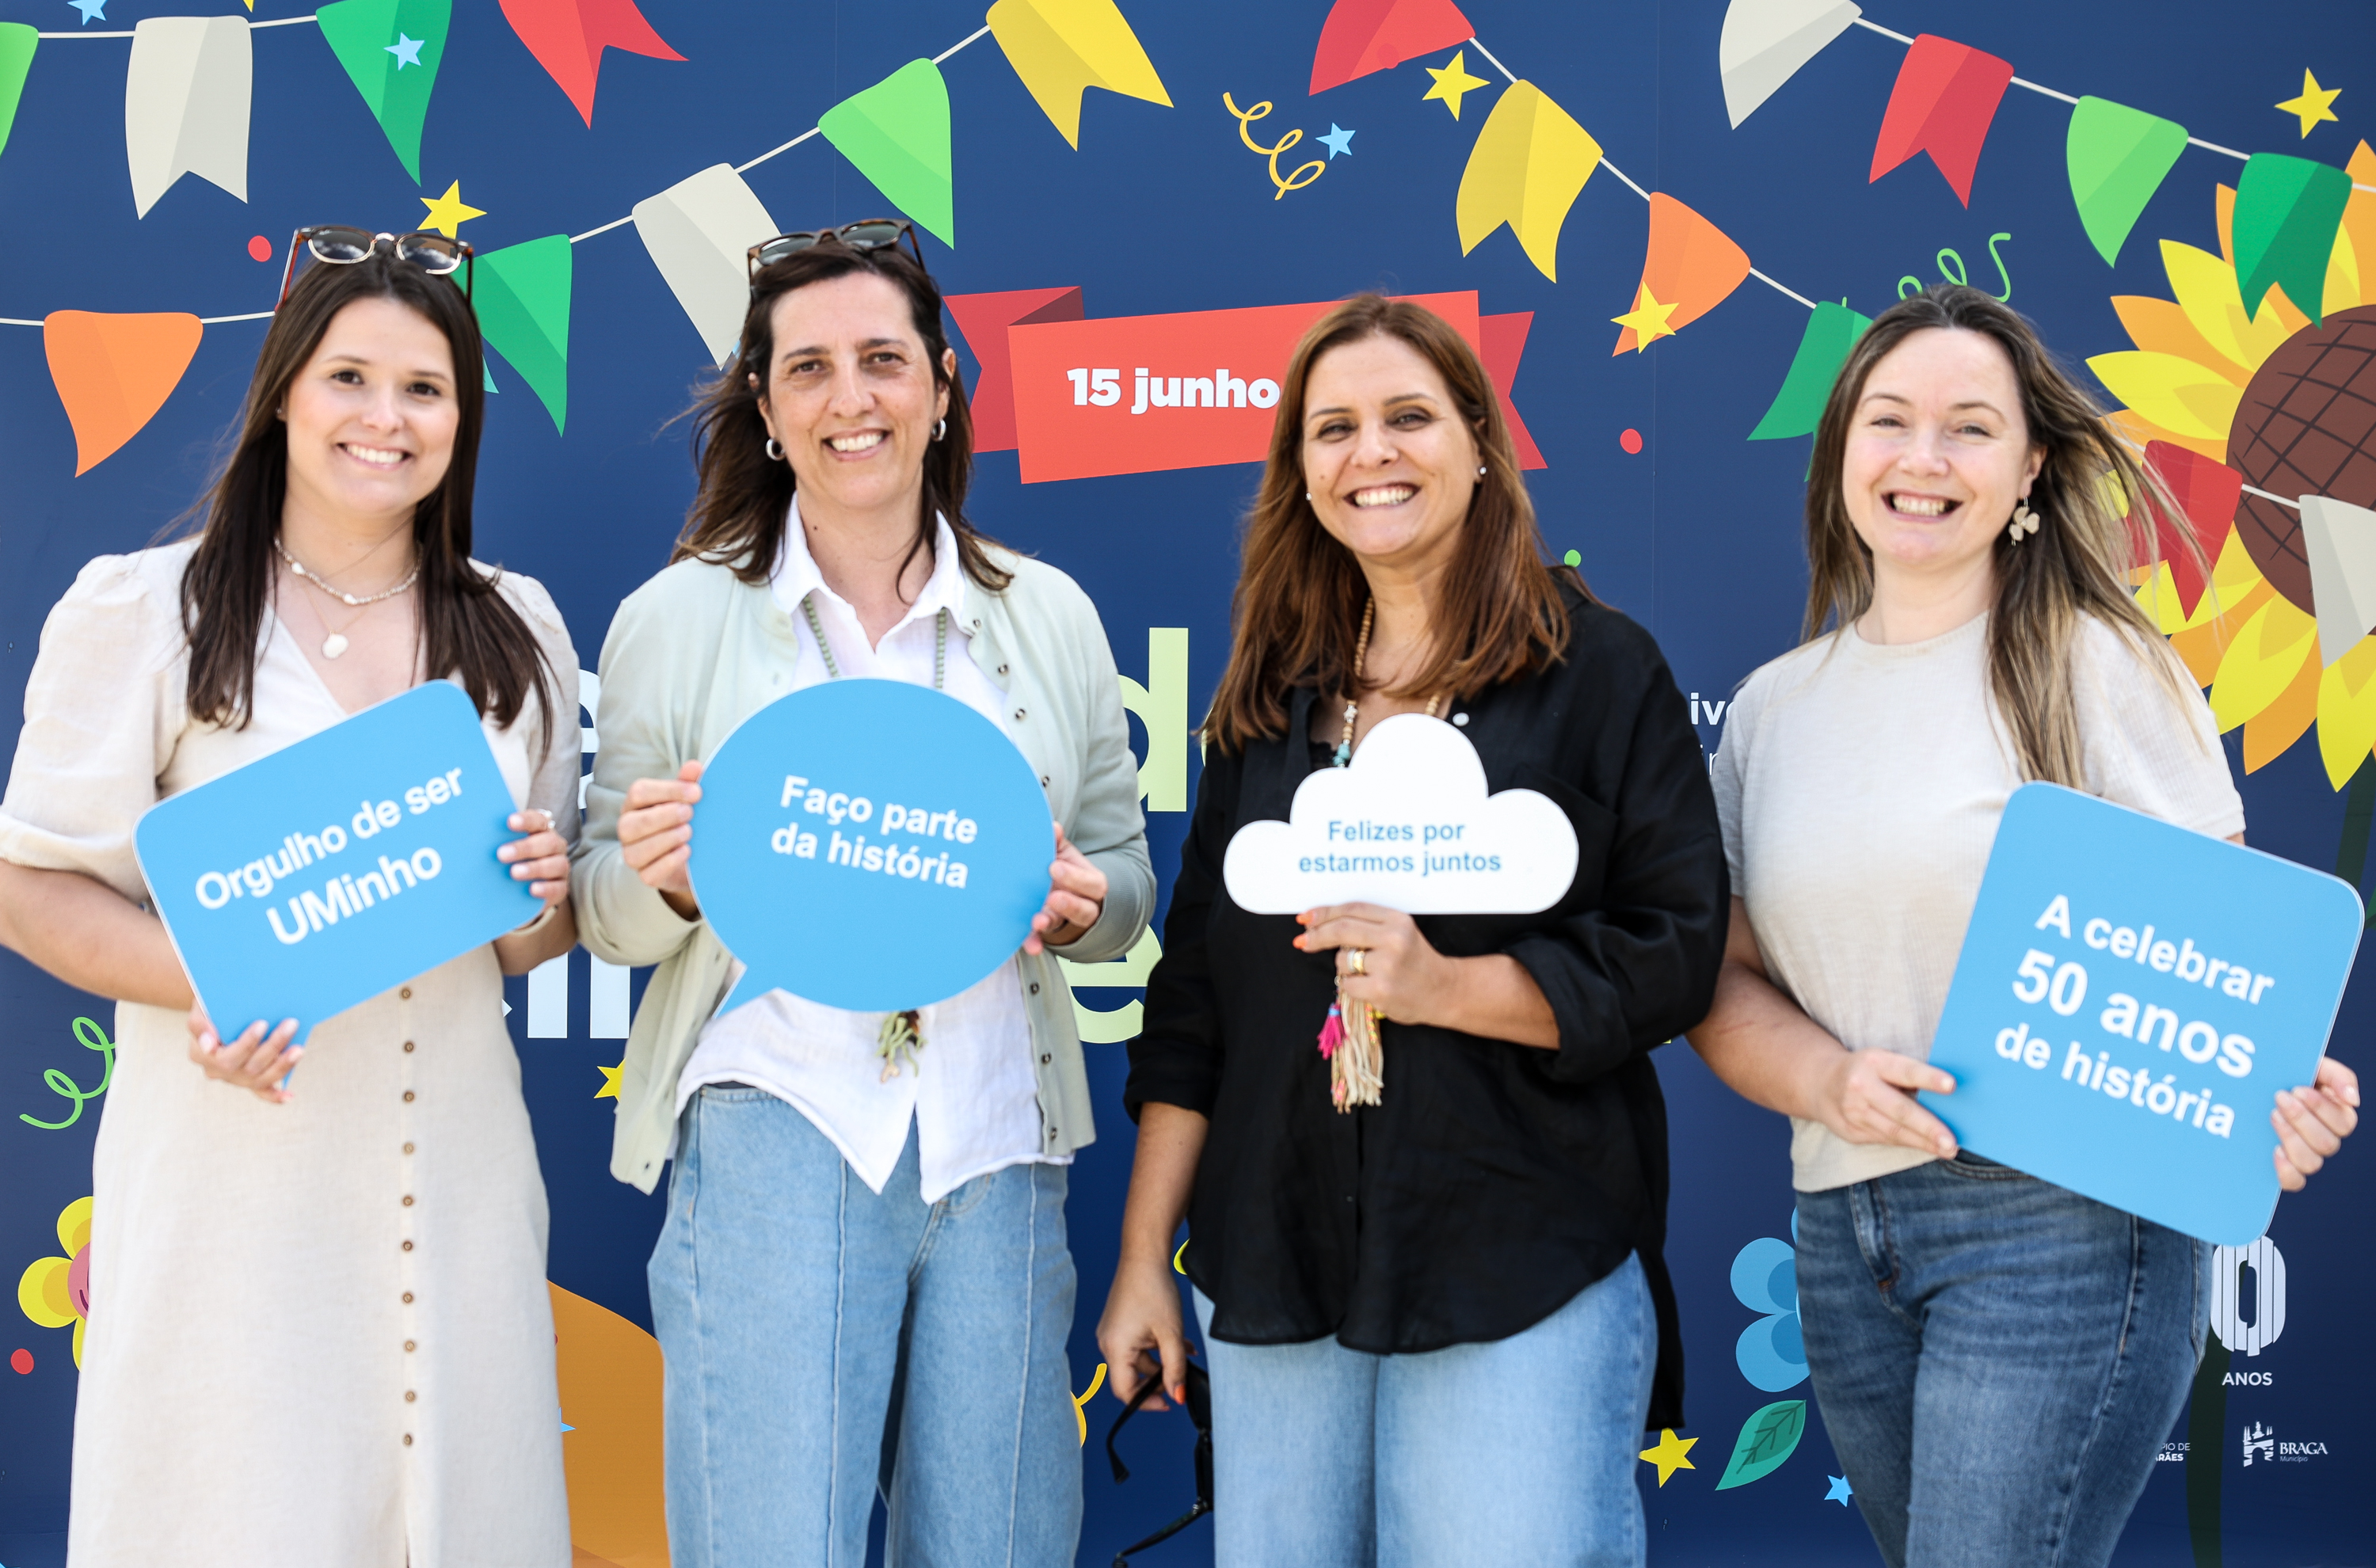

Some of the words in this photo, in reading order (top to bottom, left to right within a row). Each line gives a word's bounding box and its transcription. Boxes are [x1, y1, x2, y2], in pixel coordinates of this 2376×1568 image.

[1067, 367, 1121, 406] 15
[1131, 367, 1281, 414] junho
[195, 824, 348, 910] Orgulho
[351, 799, 402, 840] de
[404, 767, 463, 816] ser
[780, 774, 873, 826] Faço
[880, 802, 978, 844] parte
[1328, 820, 1414, 841] Felizes
[1423, 824, 1465, 844] por
[771, 821, 818, 860] da
[827, 830, 969, 889] história
[1299, 853, 1415, 872] estarmos
[1422, 851, 1502, 877] juntos
[265, 847, 443, 946] UMinho
[2034, 893, 2072, 940] A
[2083, 917, 2275, 1006] celebrar
[2012, 948, 2089, 1017] 50
[2099, 991, 2256, 1079] anos
[1994, 1022, 2052, 1071] de
[2061, 1040, 2236, 1139] história
[2222, 1372, 2273, 1386] ANOS
[2178, 1442, 2191, 1452] DE
[2279, 1442, 2328, 1455] BRAGA
